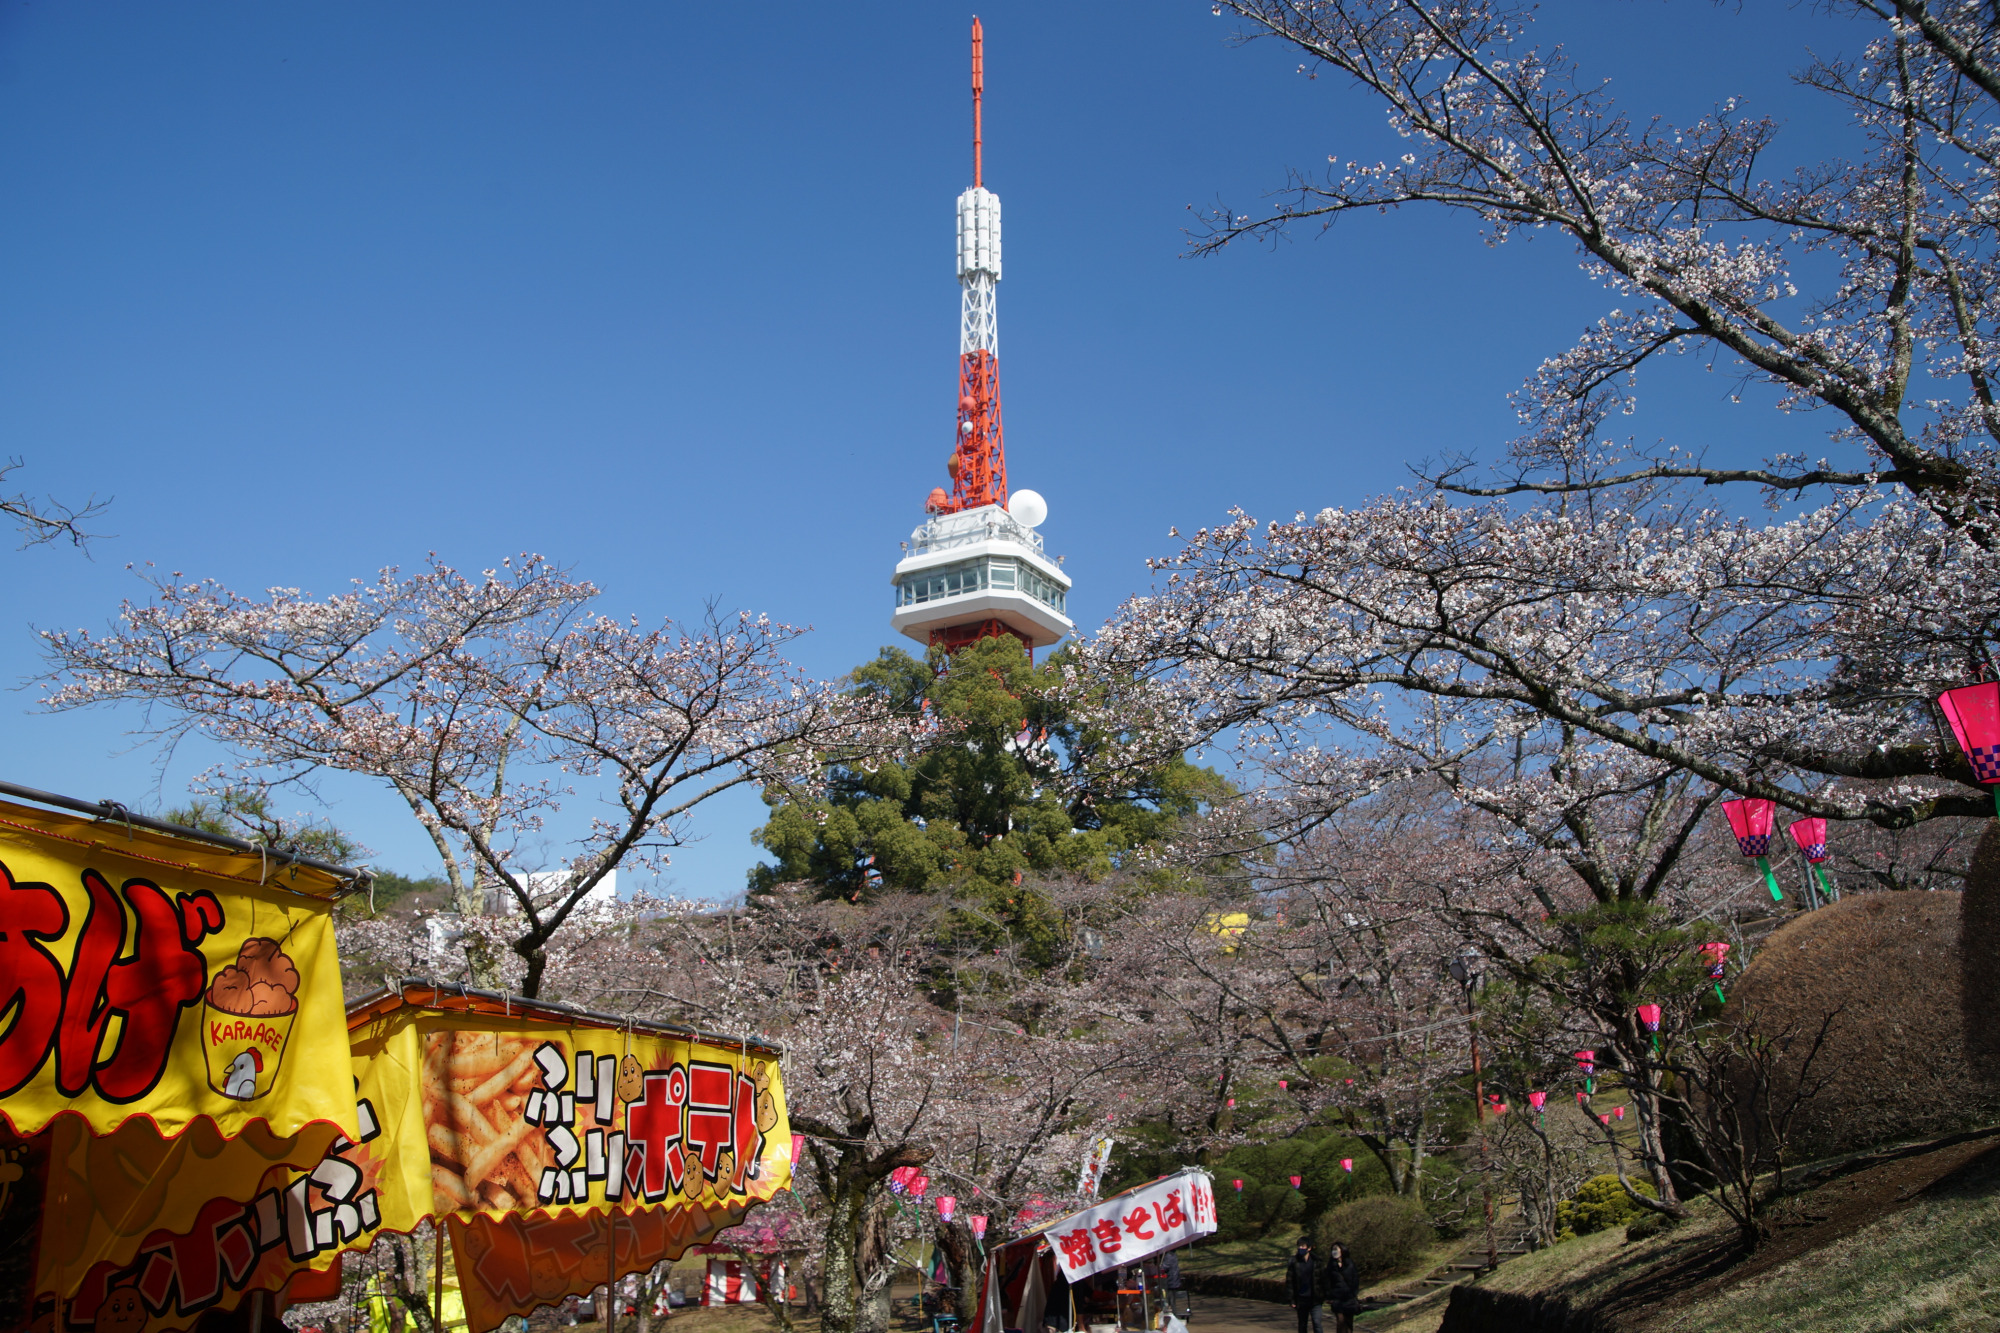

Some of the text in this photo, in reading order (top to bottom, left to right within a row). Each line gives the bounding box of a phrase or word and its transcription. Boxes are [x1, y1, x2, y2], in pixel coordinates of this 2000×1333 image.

[210, 1021, 283, 1052] KARAAGE
[1060, 1189, 1187, 1270] 焼きそば
